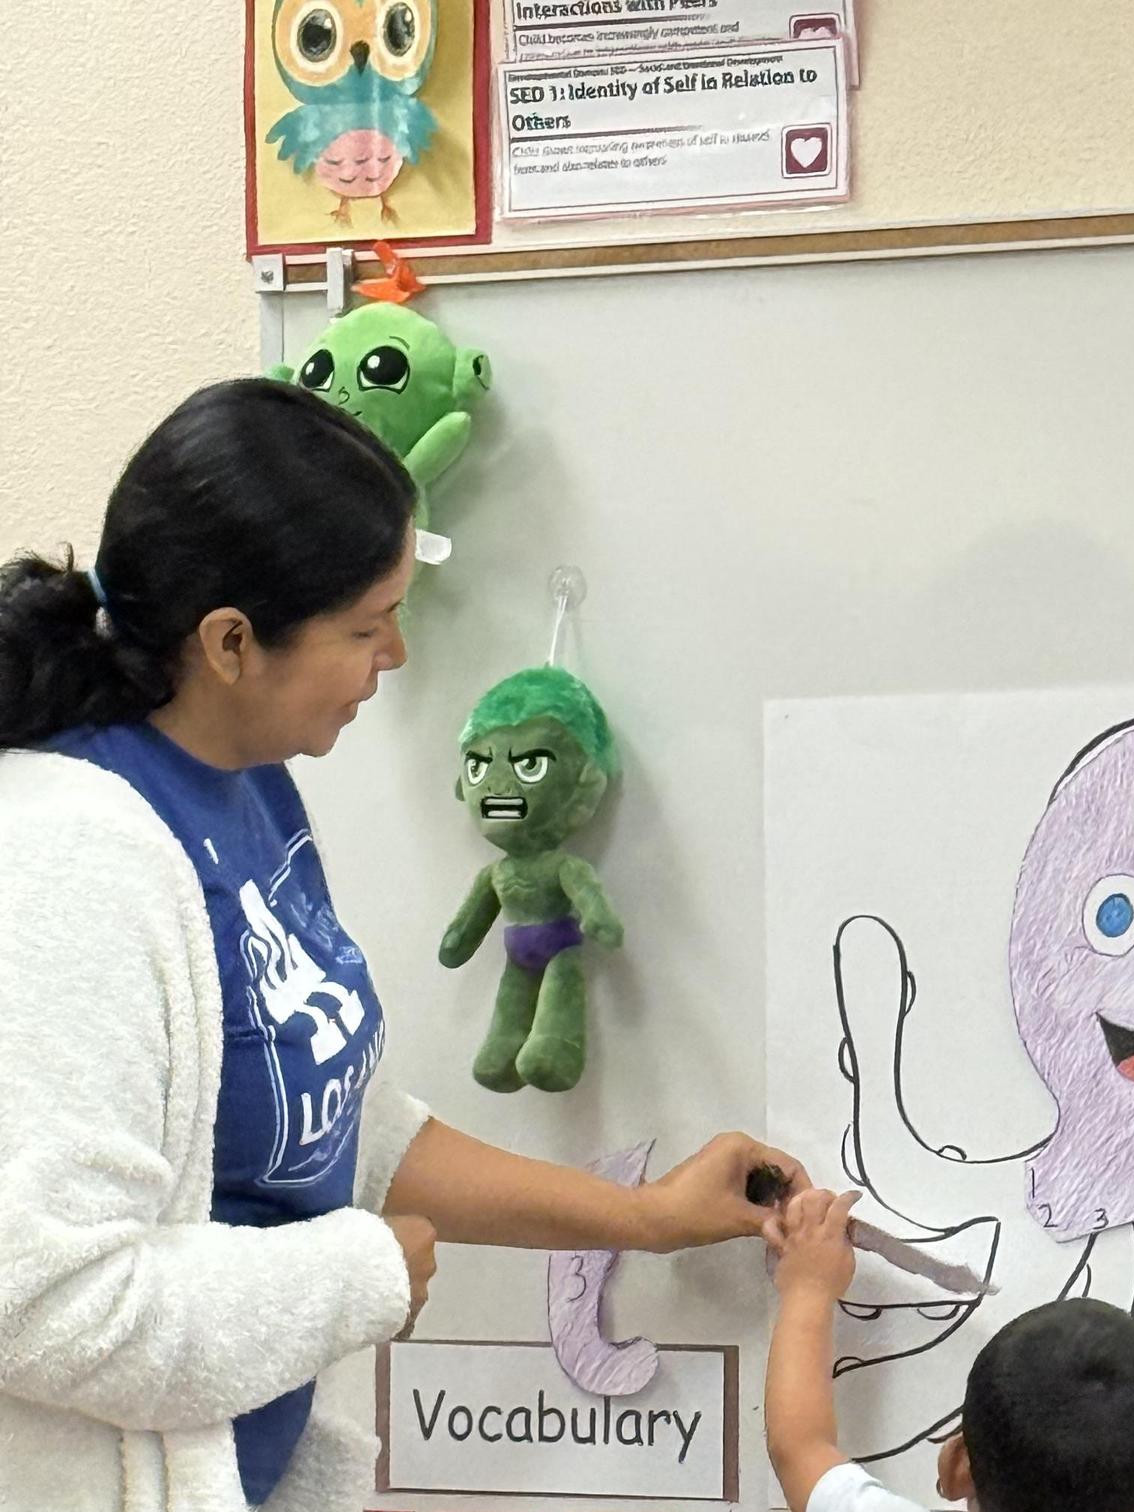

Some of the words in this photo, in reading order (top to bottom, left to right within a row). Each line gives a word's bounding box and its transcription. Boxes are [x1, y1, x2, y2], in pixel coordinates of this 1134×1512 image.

[510, 85, 545, 104] SED
[568, 78, 637, 100] Identity
[642, 75, 659, 94] of
[664, 73, 698, 93] Self
[701, 73, 718, 90] in
[722, 69, 794, 89] Relation
[800, 67, 818, 83] to
[511, 112, 571, 131] Others
[1037, 1203, 1059, 1229] 2
[1093, 1207, 1109, 1230] 3
[412, 1388, 703, 1465] Vocabulary
